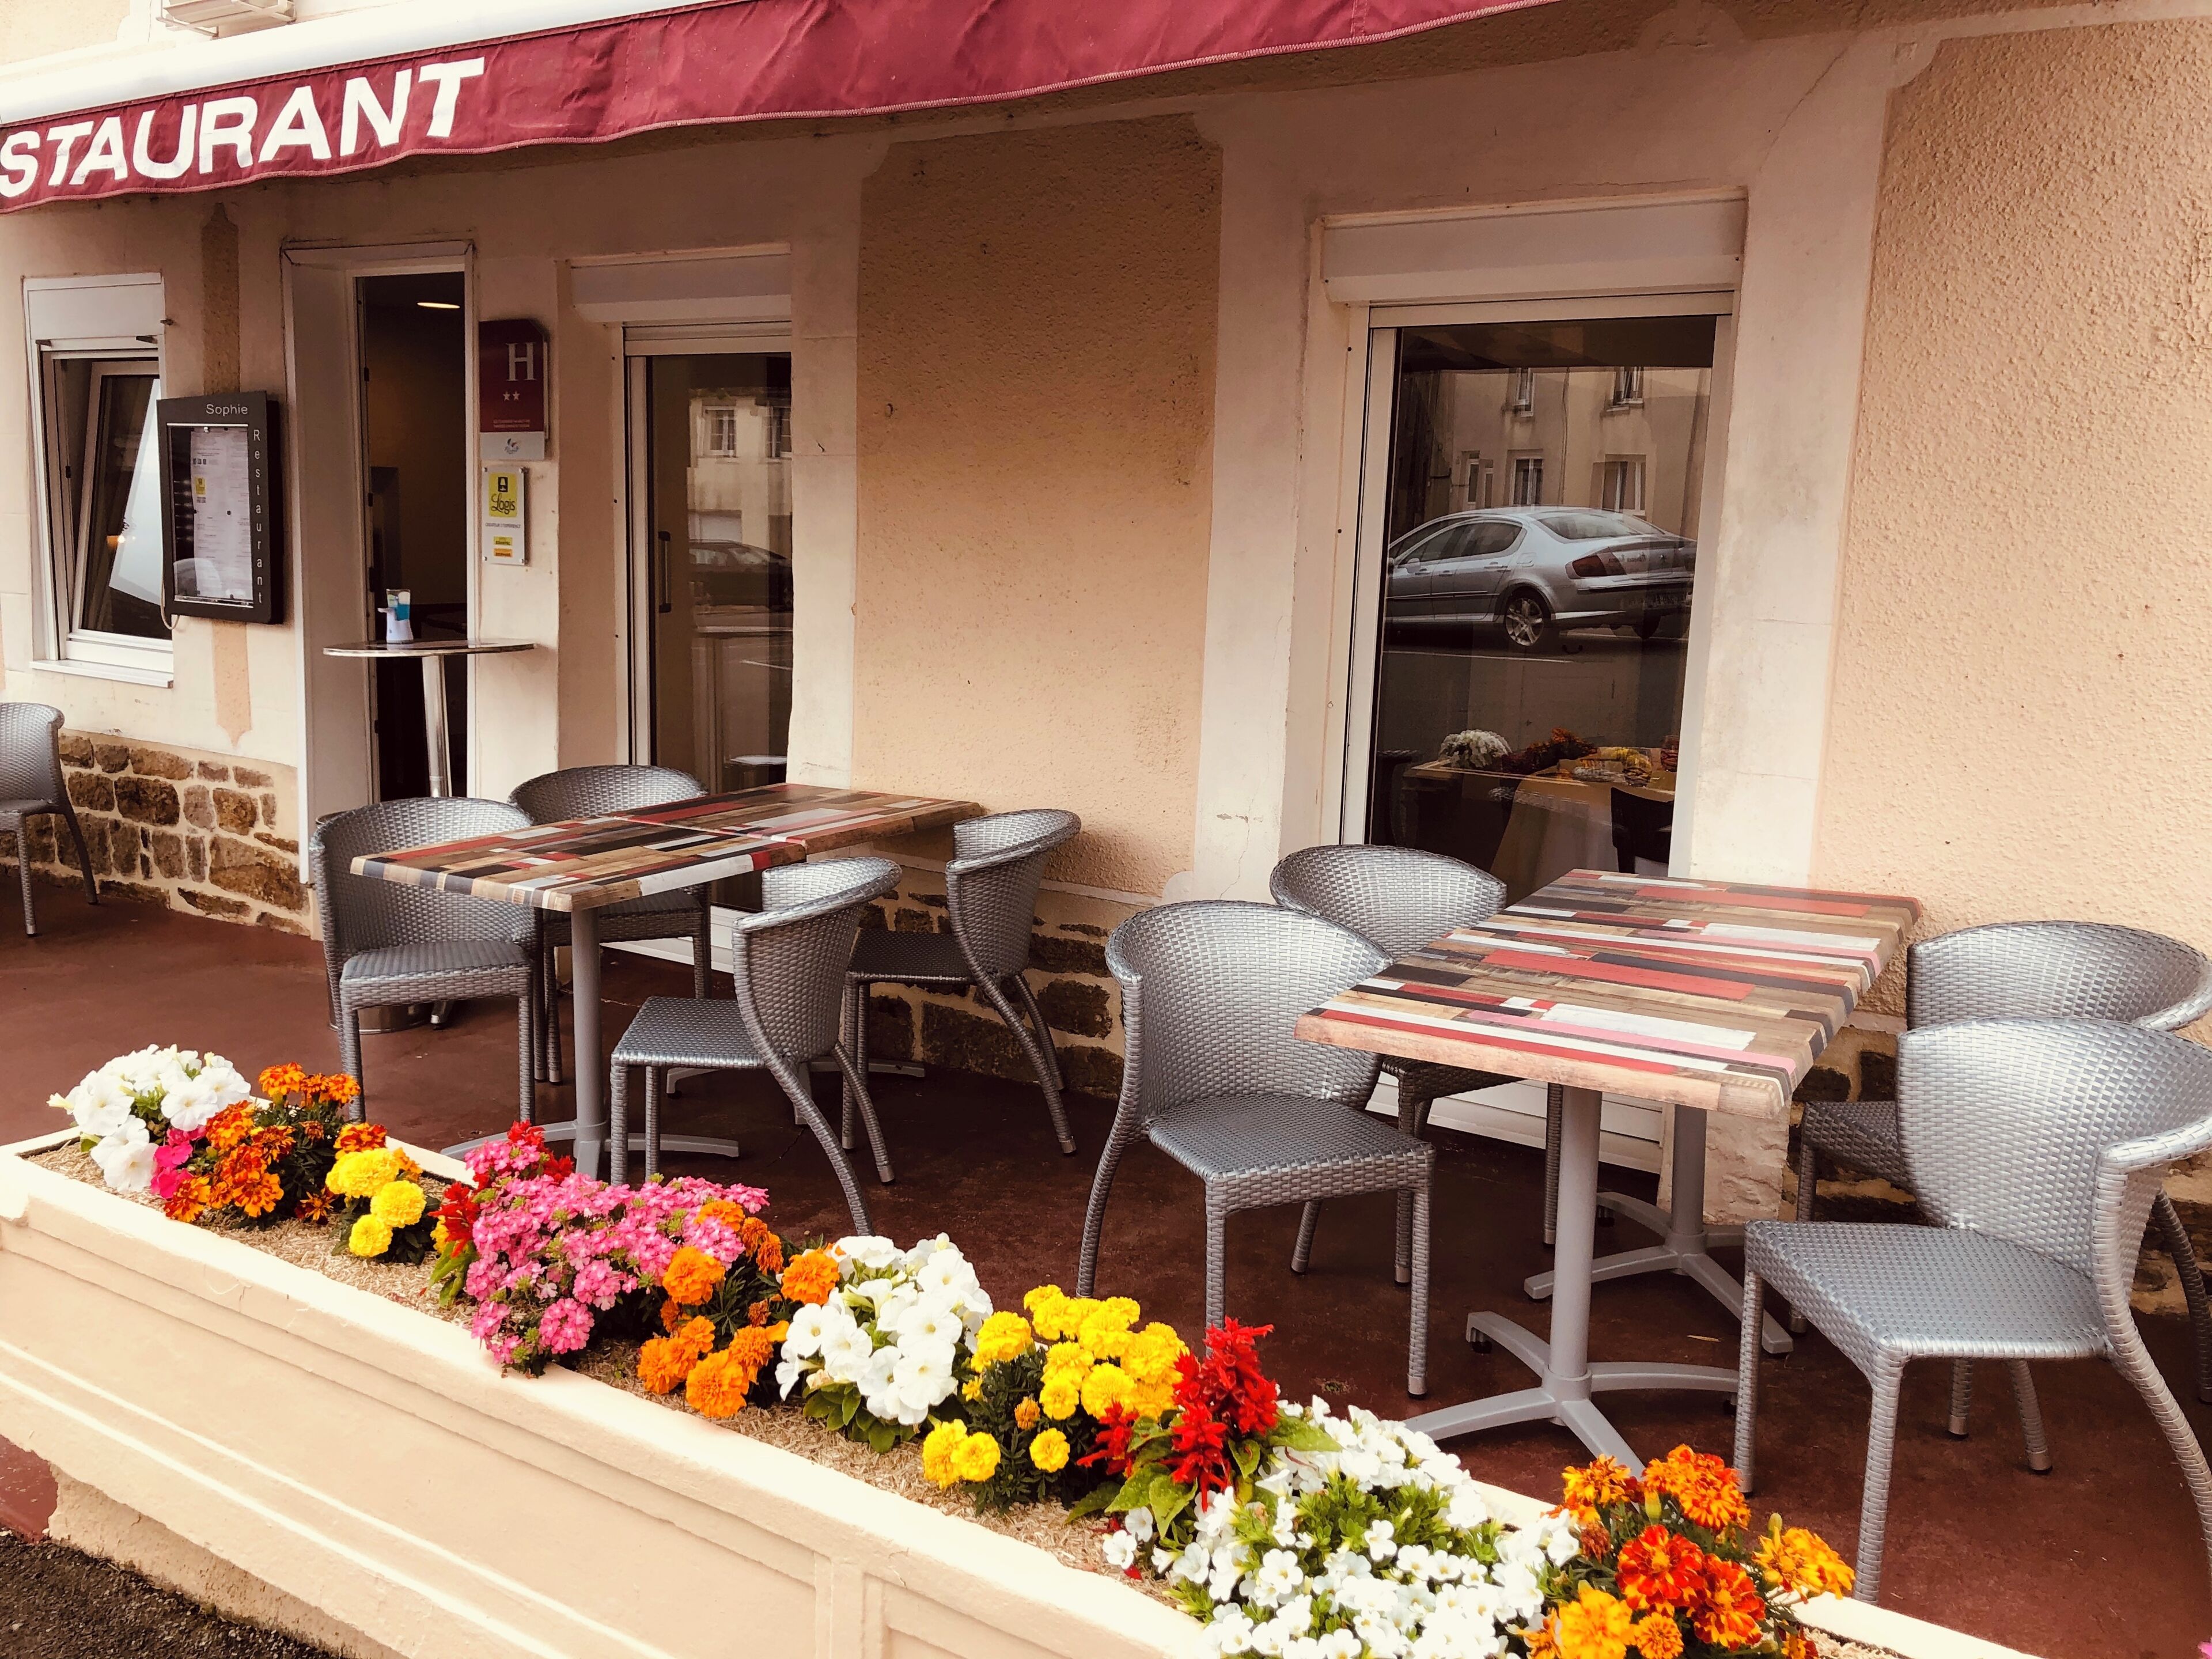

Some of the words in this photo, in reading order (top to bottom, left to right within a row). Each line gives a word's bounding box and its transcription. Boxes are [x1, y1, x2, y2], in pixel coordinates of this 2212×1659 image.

[0, 56, 485, 198] STAURANT
[506, 342, 537, 381] H
[206, 404, 248, 416] Sophie
[253, 429, 263, 604] Restaurant
[491, 493, 516, 515] Logis
